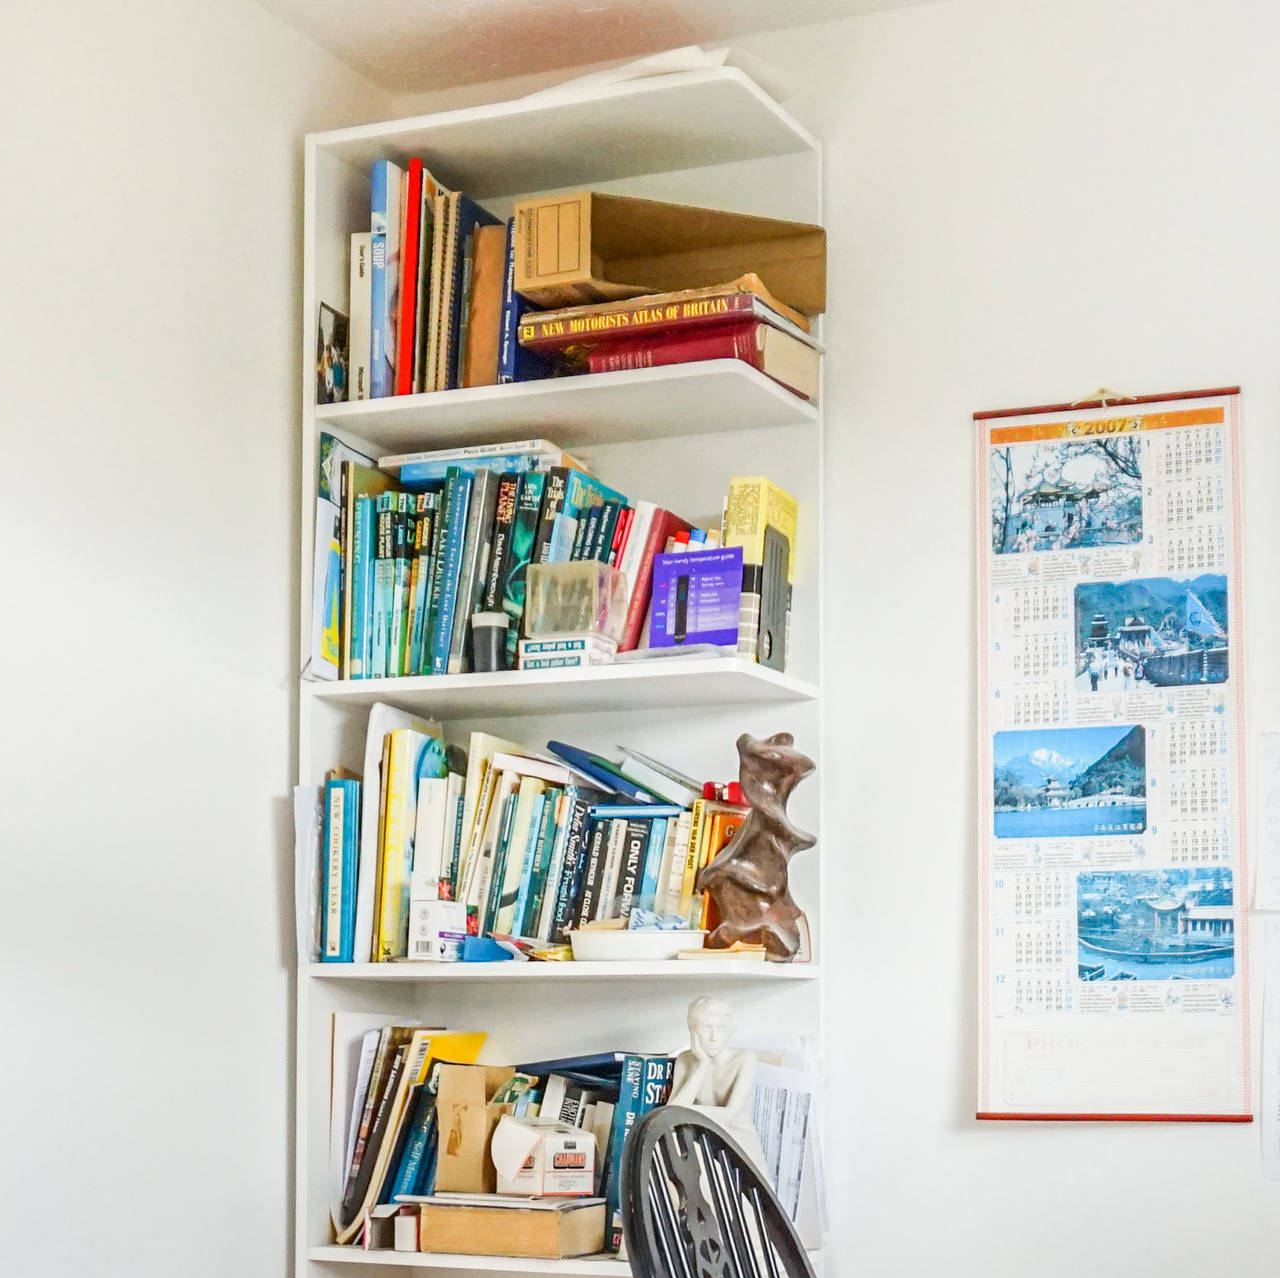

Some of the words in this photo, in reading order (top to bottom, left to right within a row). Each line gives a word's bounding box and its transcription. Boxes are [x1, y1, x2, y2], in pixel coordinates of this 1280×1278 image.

[372, 242, 385, 269] SOUP
[542, 323, 565, 337] NEW
[569, 313, 629, 333] MOTORISTS
[632, 308, 663, 325] ATLAS
[666, 304, 679, 320] OF
[683, 298, 729, 318] BRITAIN
[1084, 418, 1127, 435] 2007
[547, 487, 565, 500] Trials
[552, 475, 564, 488] The
[496, 482, 510, 521] PLANET
[505, 498, 515, 524] LIVING
[437, 530, 448, 558] LAKE
[496, 533, 505, 554] David
[432, 559, 446, 609] DISTRICT
[487, 555, 503, 607] Attenborough
[572, 804, 586, 830] Delia
[693, 801, 702, 828] LAURENS
[331, 825, 339, 878] COOKERY
[567, 833, 580, 866] Smith's
[591, 832, 602, 857] GERALD
[627, 840, 641, 875] ONLY
[687, 855, 695, 870] POST
[561, 870, 572, 902] Frugal
[330, 886, 338, 914] YEAR
[581, 898, 591, 918] CLOSE
[626, 1060, 634, 1083] SANE
[632, 1060, 642, 1099] STAYING
[647, 1062, 663, 1080] DR
[625, 1112, 635, 1126] DR
[413, 1141, 423, 1159] Self
